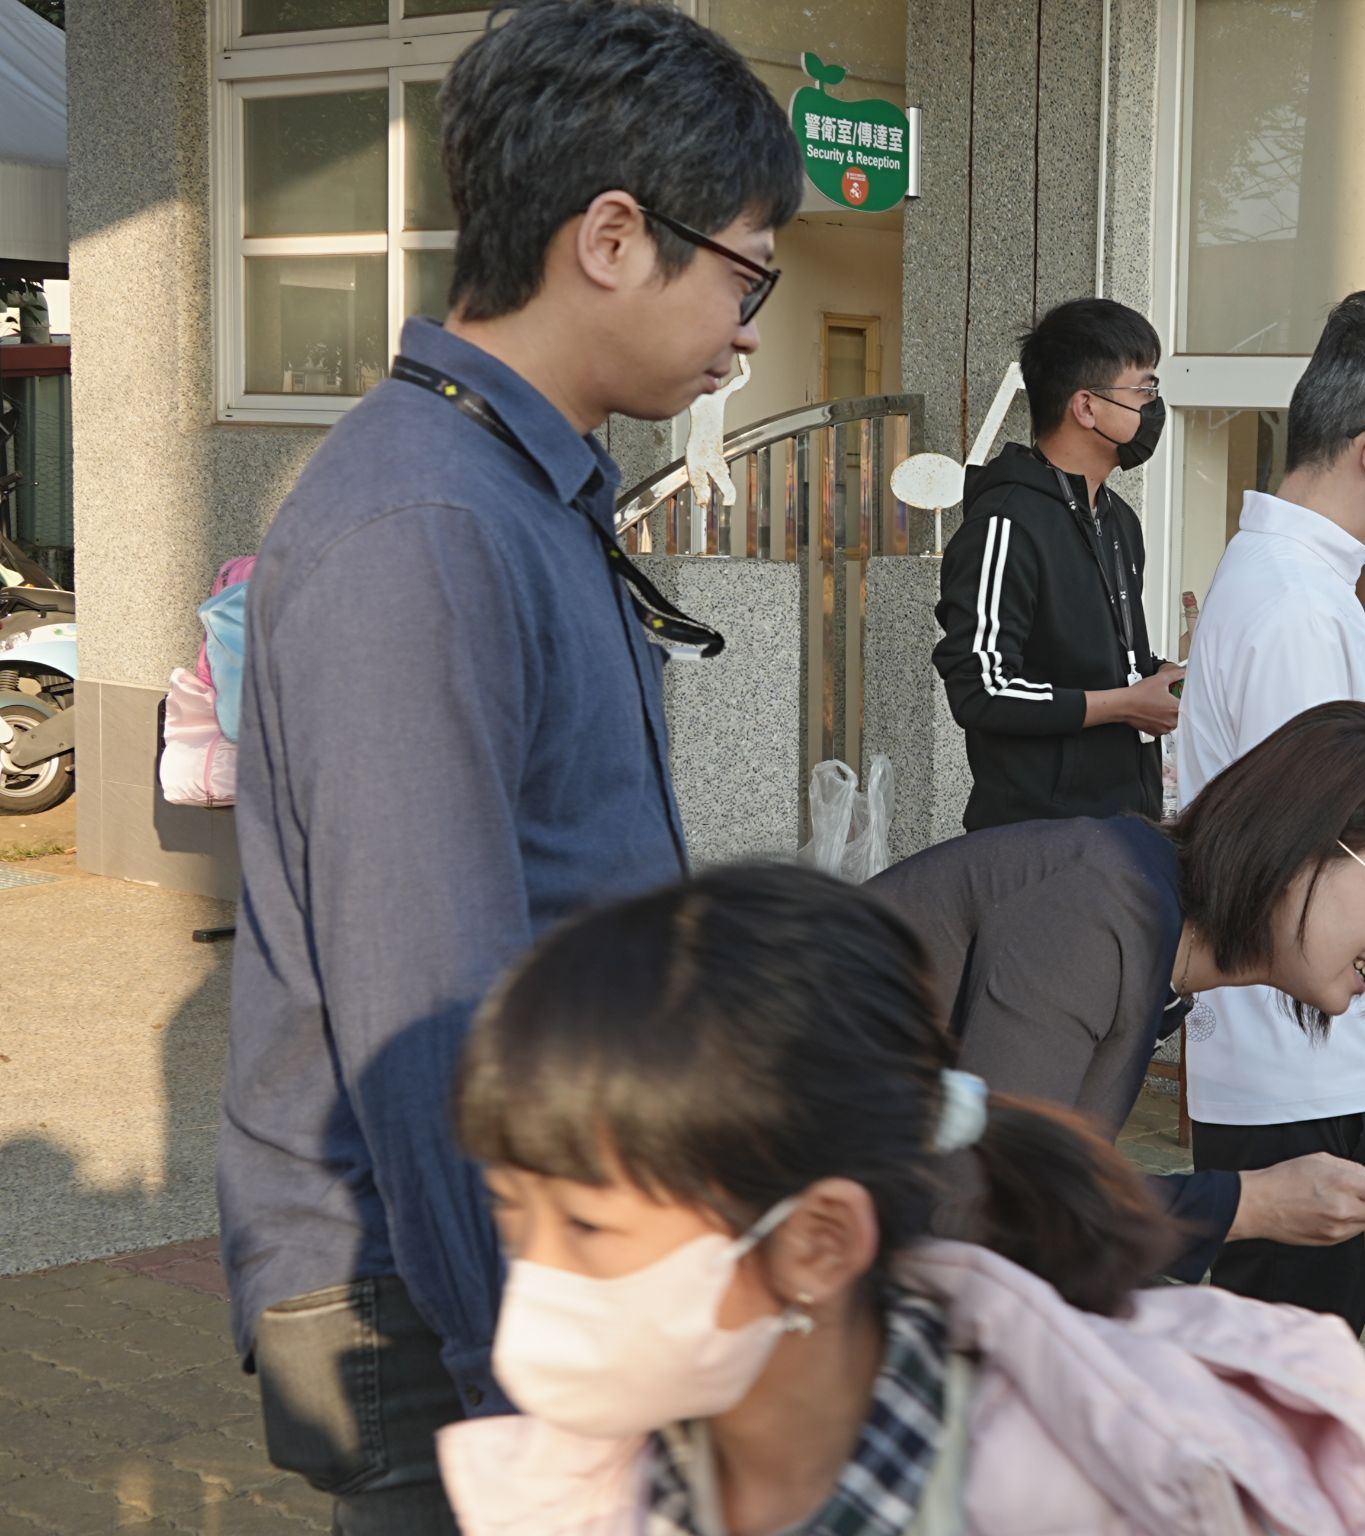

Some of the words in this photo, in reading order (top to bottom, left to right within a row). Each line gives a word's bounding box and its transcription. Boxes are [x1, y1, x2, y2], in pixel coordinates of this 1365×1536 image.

[805, 112, 904, 153] 警衛室/傳達室
[806, 144, 845, 165] Security
[846, 150, 854, 163] &
[856, 151, 901, 170] Reception
